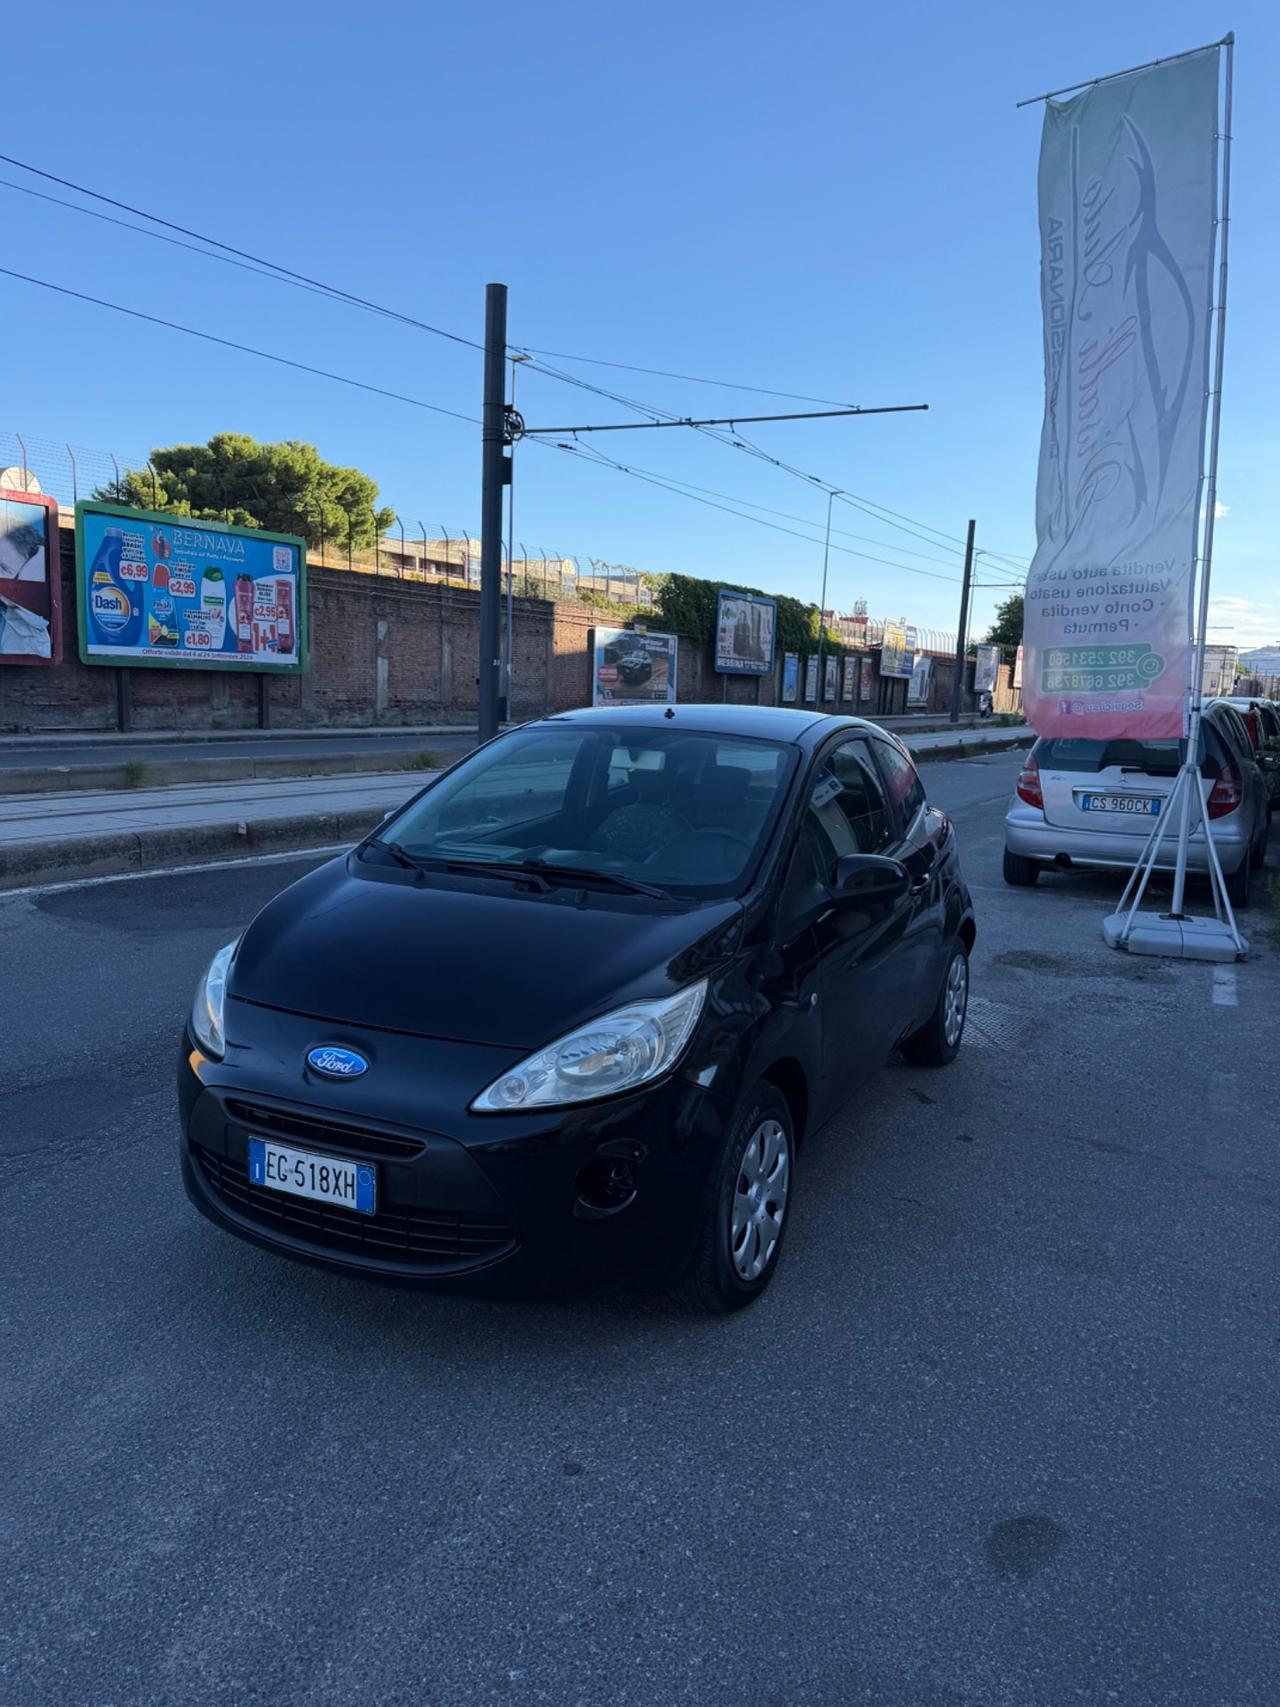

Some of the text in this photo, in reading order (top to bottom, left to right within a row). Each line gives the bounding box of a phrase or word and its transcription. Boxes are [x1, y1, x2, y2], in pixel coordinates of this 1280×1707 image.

[173, 529, 245, 554] BERNAVA
[95, 594, 122, 610] Dash
[1091, 797, 1107, 809] CS
[1111, 798, 1150, 813] 960CK
[316, 1050, 354, 1074] Ford
[266, 1151, 288, 1182] EG
[294, 1159, 356, 1201] 518XH
